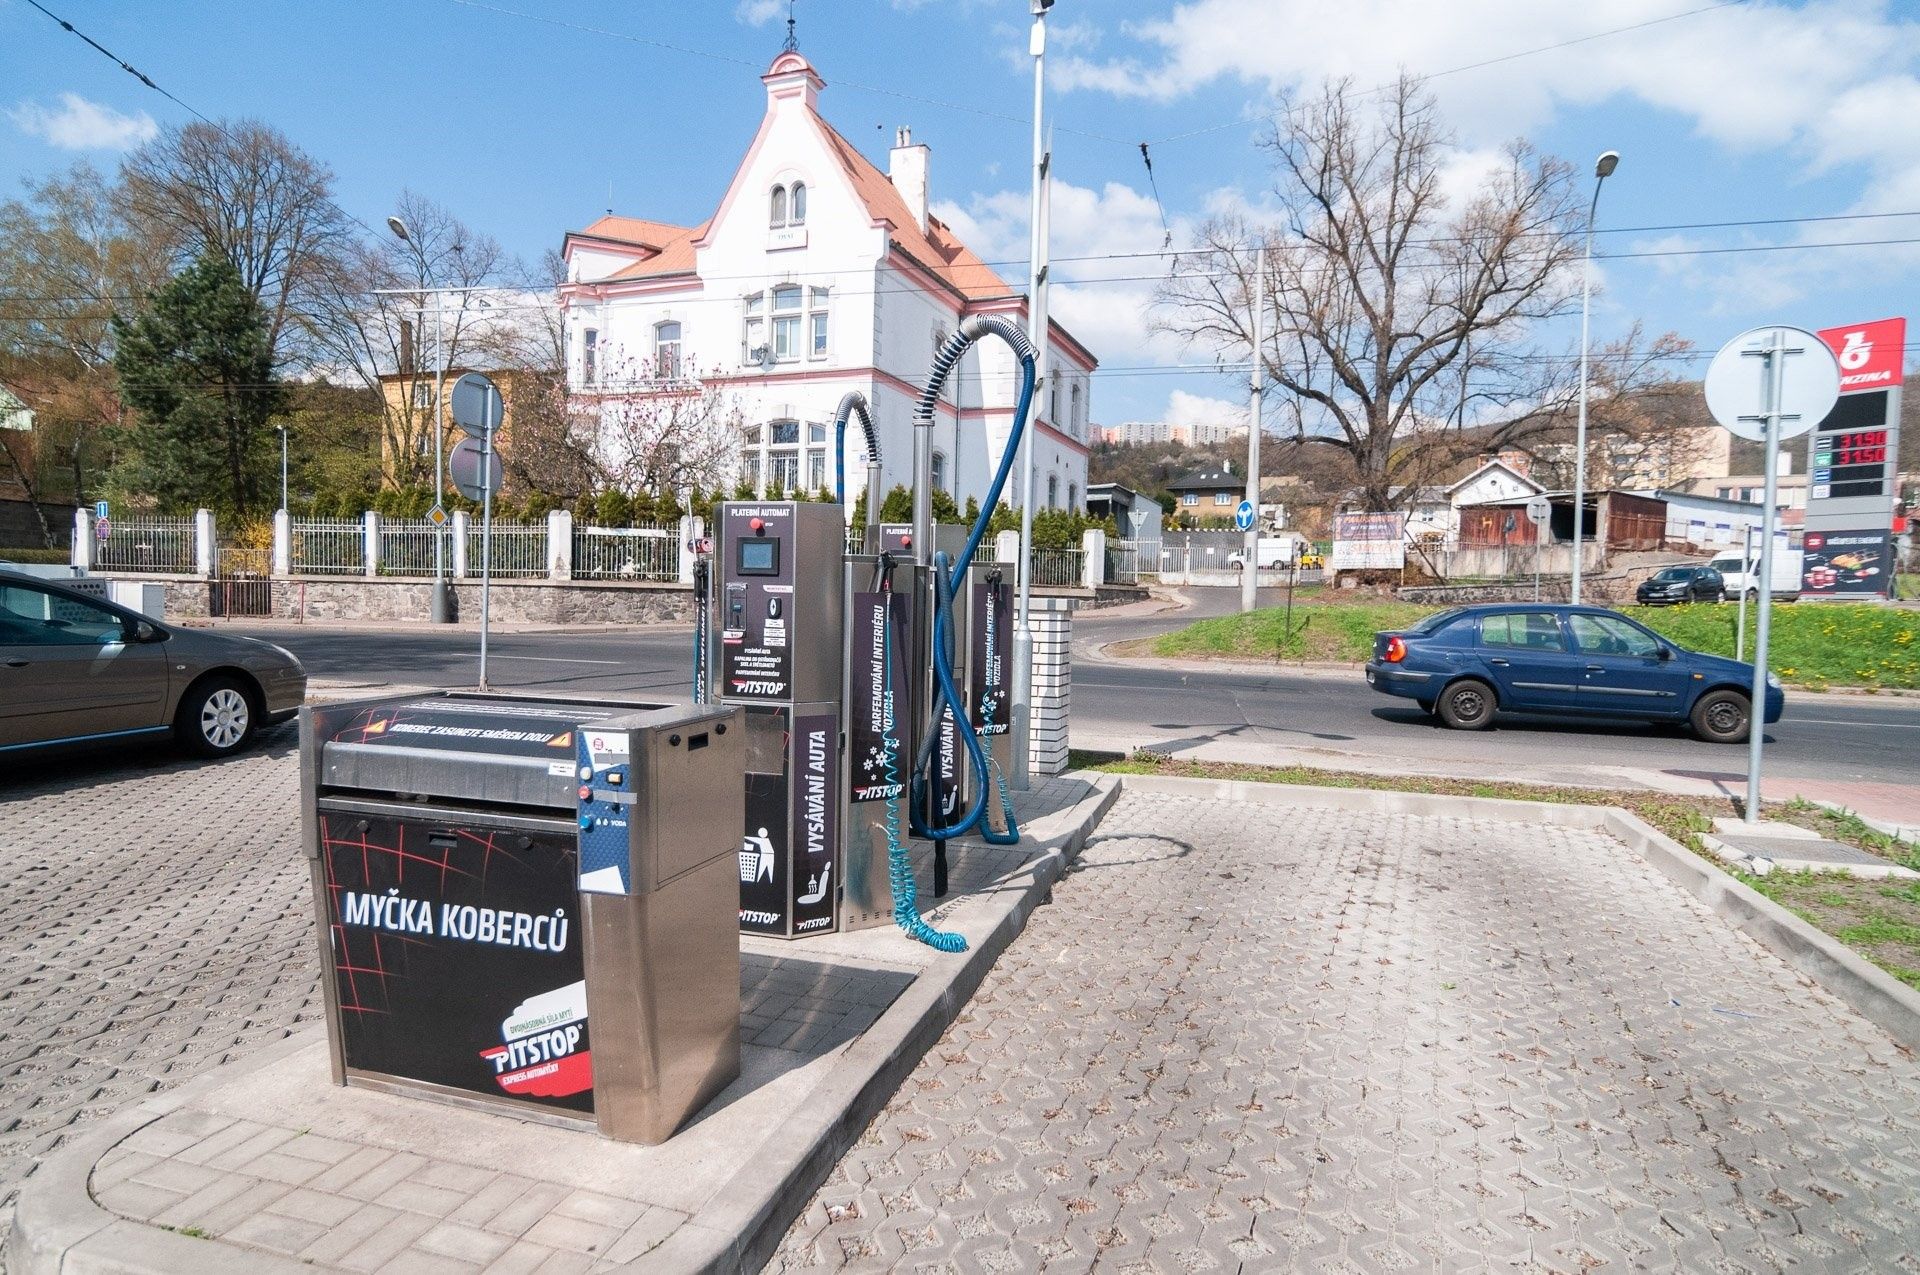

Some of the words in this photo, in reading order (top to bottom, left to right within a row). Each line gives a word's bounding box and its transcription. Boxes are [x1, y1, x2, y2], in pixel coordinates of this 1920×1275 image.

[1840, 371, 1891, 385] NZINA
[731, 507, 760, 517] PLATEBNÍ
[760, 508, 790, 517] AUTOMAT
[872, 605, 884, 659] INTERIÉRU
[993, 655, 1001, 686] VOZIDLA
[733, 680, 784, 695] PITSTOP
[871, 660, 883, 733] PARFEMOVÁNÍ
[389, 723, 434, 734] KOBEREC
[430, 726, 483, 738] ZASUNETE
[479, 728, 527, 741] SMĚREM
[523, 732, 554, 743] DOLU
[974, 723, 1007, 735] PITSTOP
[808, 730, 826, 773] AUTA
[940, 721, 954, 779] VYSÁVÁNÍ
[855, 783, 903, 800] PITSTOP
[804, 774, 825, 853] VYSÁVÁNÍ
[345, 887, 434, 935] MYČKA
[441, 903, 569, 953] KOBERCŮ
[797, 916, 831, 930] PITSTOP
[546, 1012, 559, 1024] SÍLA
[559, 1007, 574, 1020] MYTÍ
[484, 1025, 580, 1073] PITSTOP
